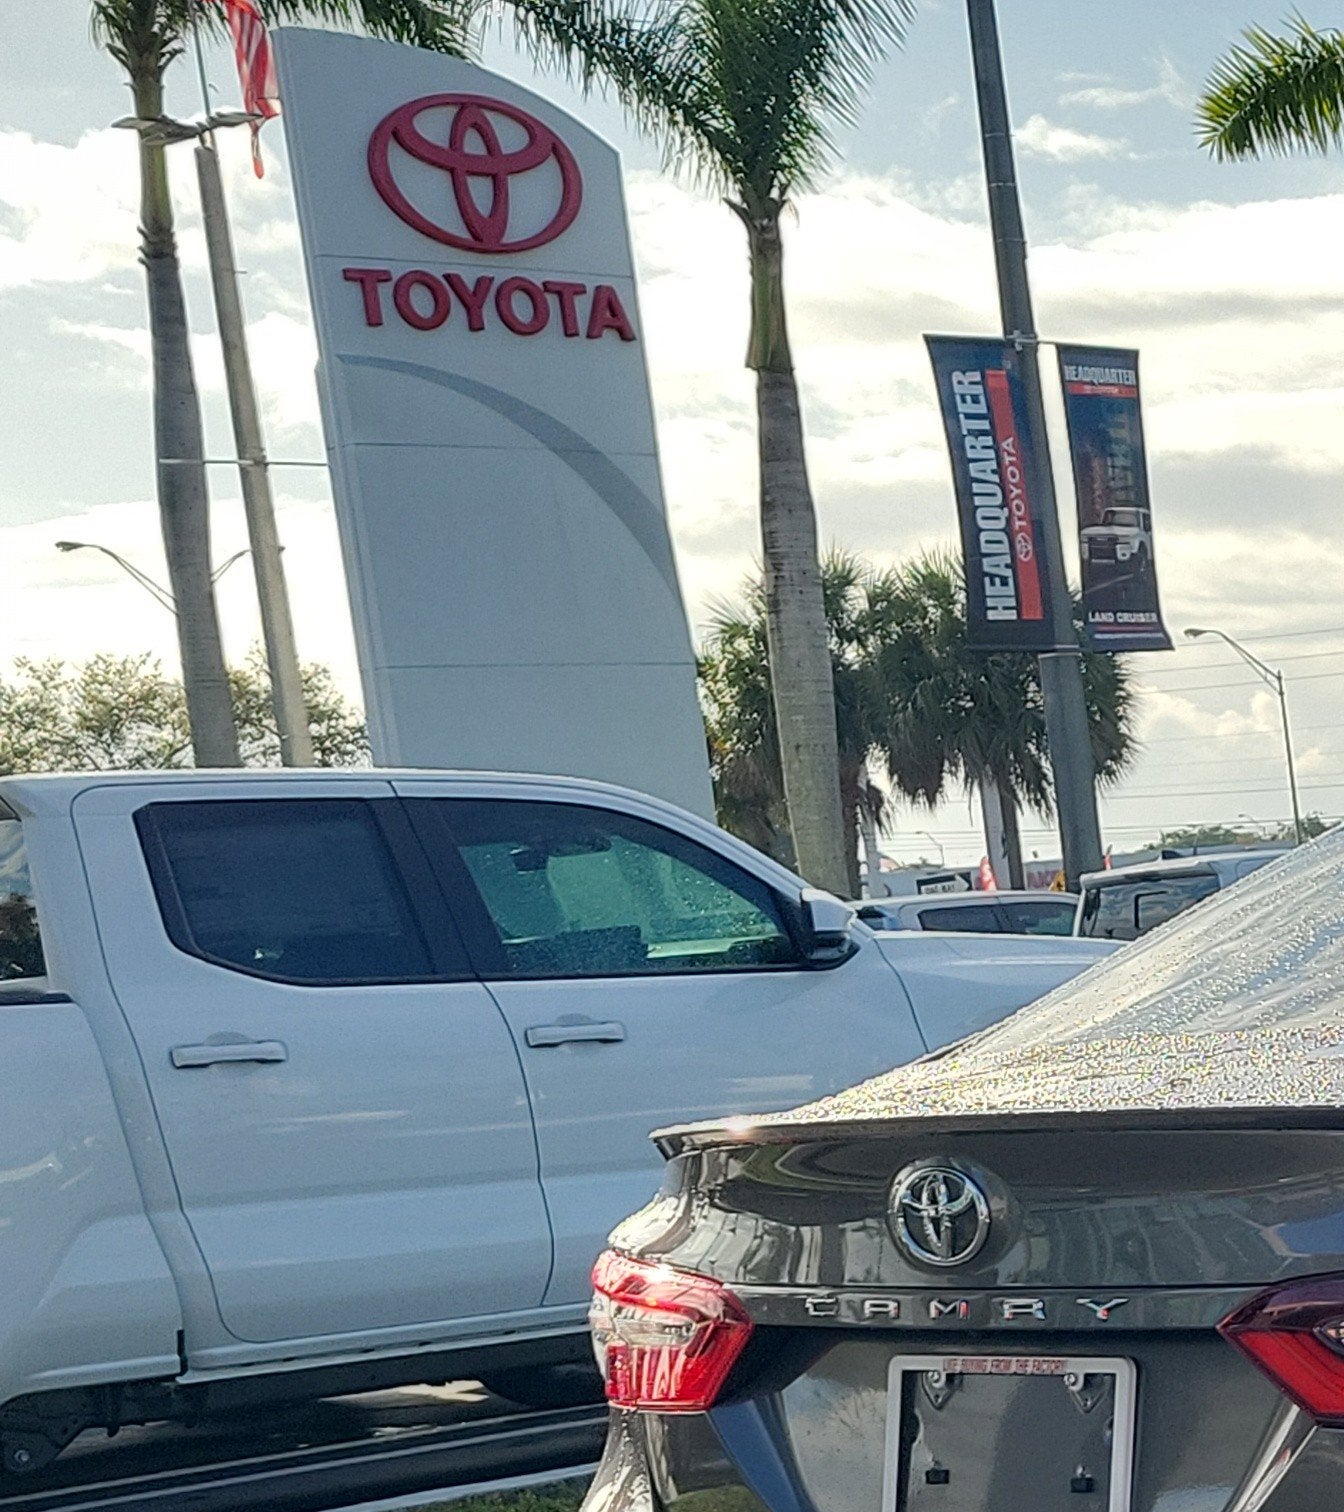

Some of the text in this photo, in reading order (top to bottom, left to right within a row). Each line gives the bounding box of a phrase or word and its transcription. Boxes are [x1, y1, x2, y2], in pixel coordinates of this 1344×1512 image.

[342, 266, 636, 341] TOYOTA
[952, 370, 1018, 621] HEADQUARTER
[1001, 437, 1029, 530] TOYOTA
[1088, 611, 1115, 622] LAND
[805, 1297, 1130, 1320] CAMRY
